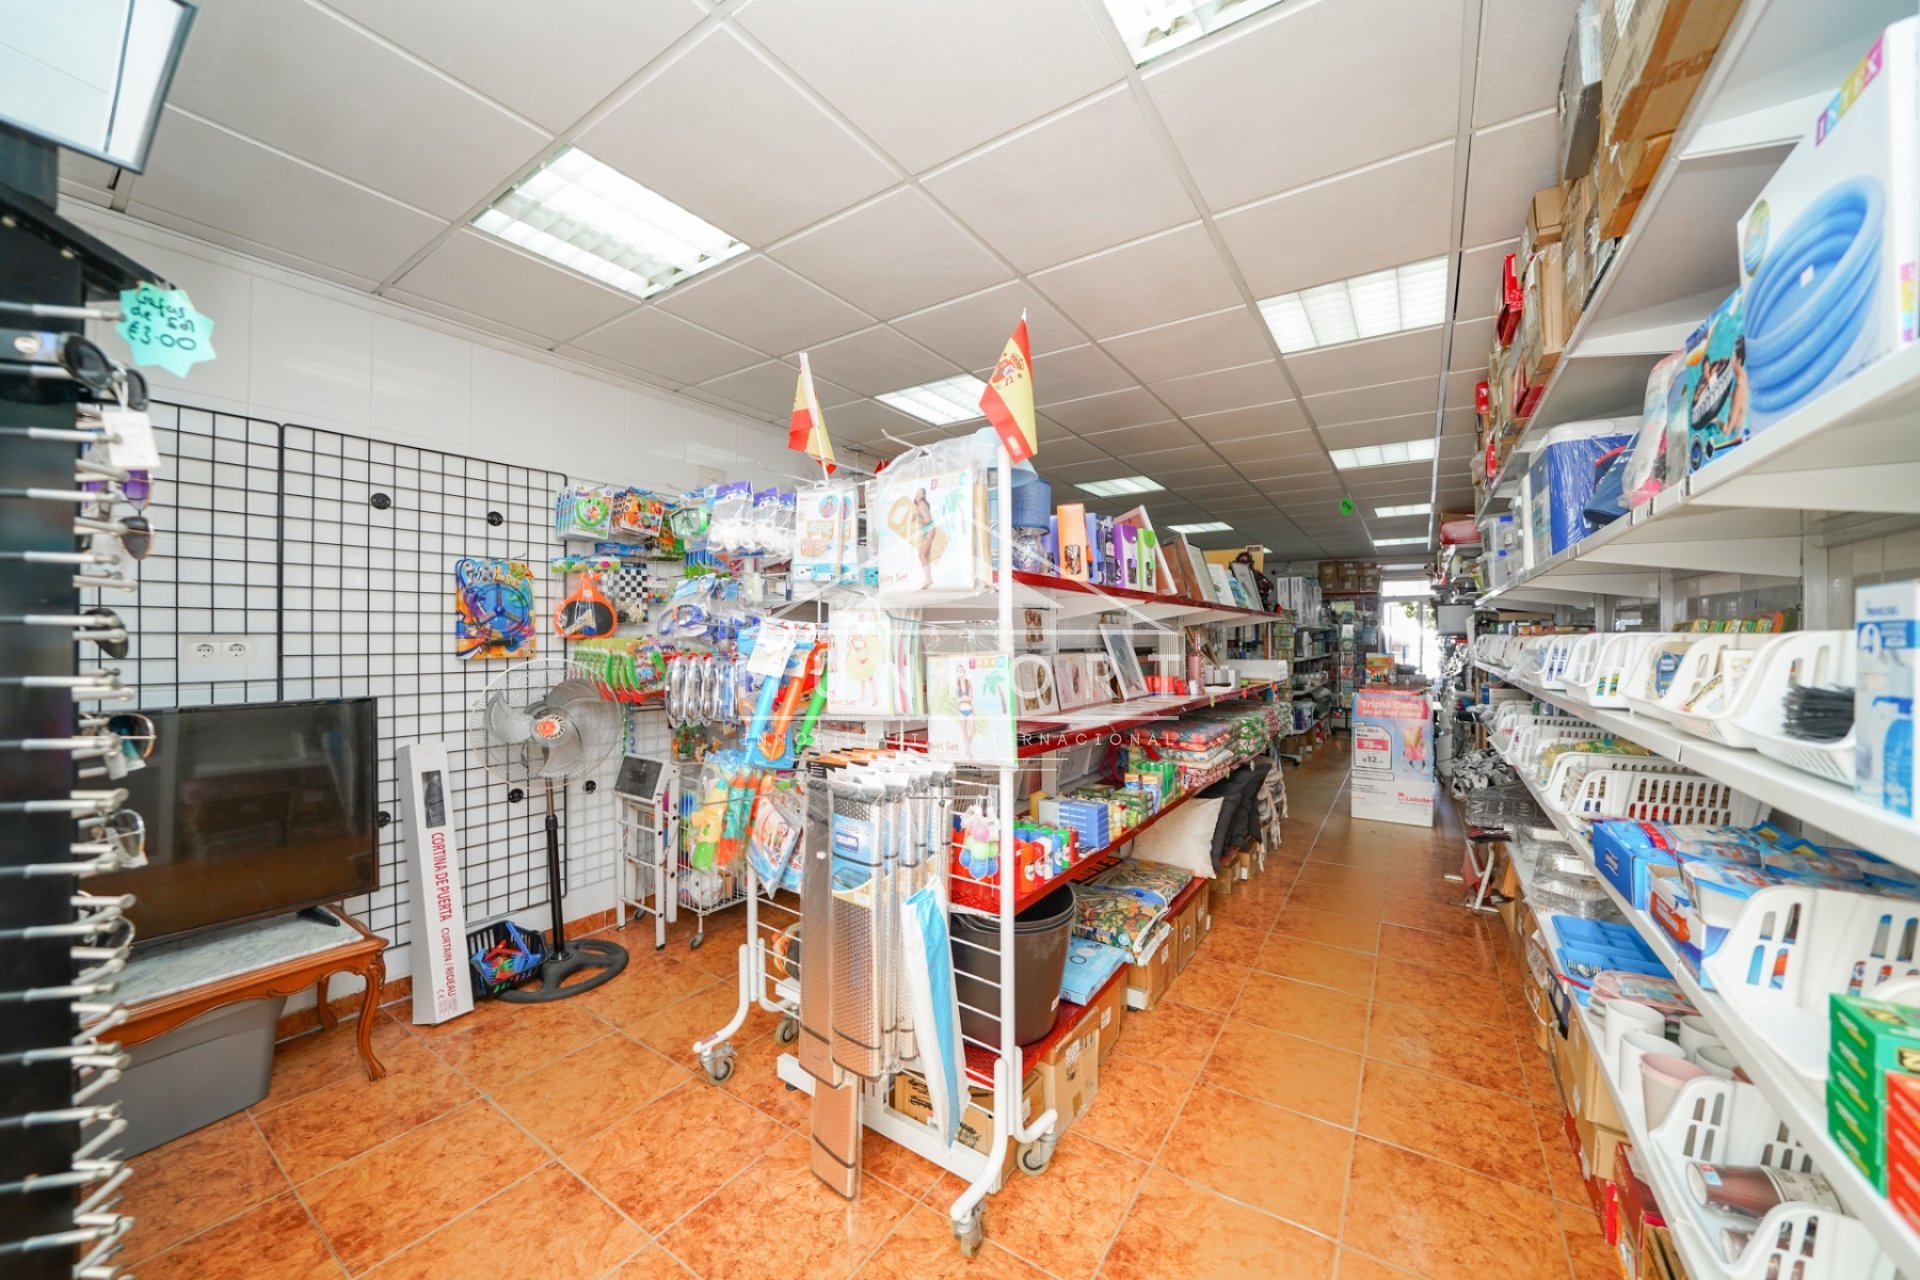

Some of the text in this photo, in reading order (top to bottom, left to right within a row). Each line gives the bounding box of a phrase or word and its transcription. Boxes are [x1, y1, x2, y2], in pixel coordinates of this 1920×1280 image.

[1815, 35, 1884, 147] INTEX
[130, 305, 152, 321] de
[431, 832, 448, 872] CORTINA
[435, 872, 449, 886] DE
[437, 886, 453, 922] PUERTA
[441, 927, 453, 962] CURTAIN
[446, 966, 457, 997] RIDEAU
